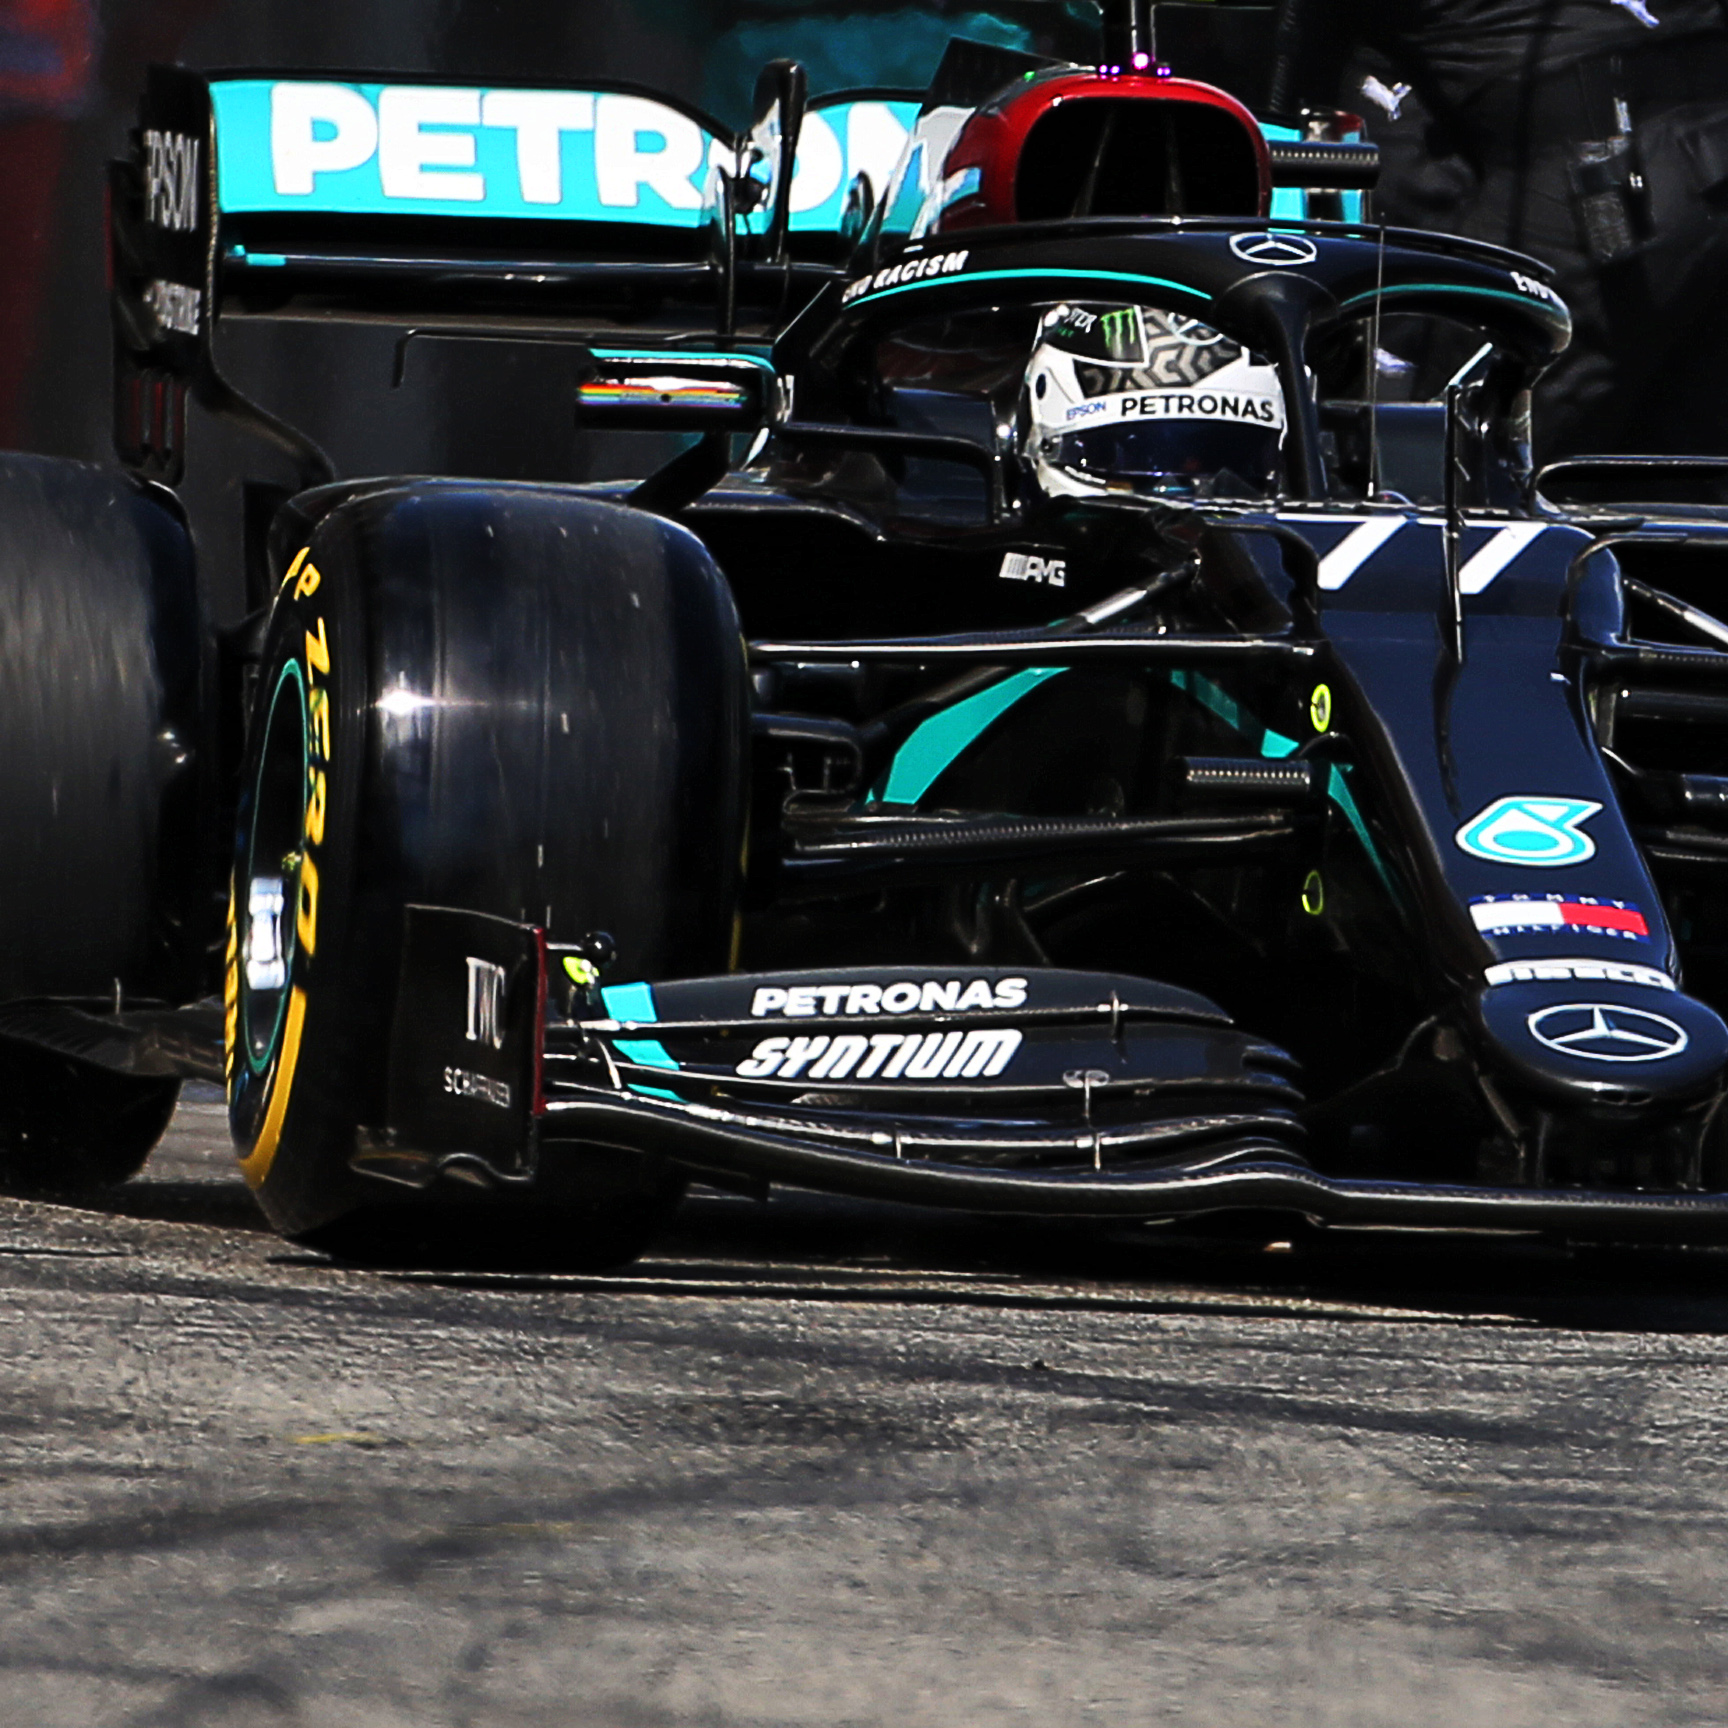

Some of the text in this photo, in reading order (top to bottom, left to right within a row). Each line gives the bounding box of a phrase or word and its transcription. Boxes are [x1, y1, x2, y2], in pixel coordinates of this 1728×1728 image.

[271, 84, 910, 214] PETRON
[873, 250, 969, 289] RACISM
[1066, 394, 1276, 423] EPSON PETRONAS
[1275, 513, 1546, 594] 77
[750, 978, 1028, 1019] PETRONAS
[736, 1029, 1024, 1079] SYNTIUM
